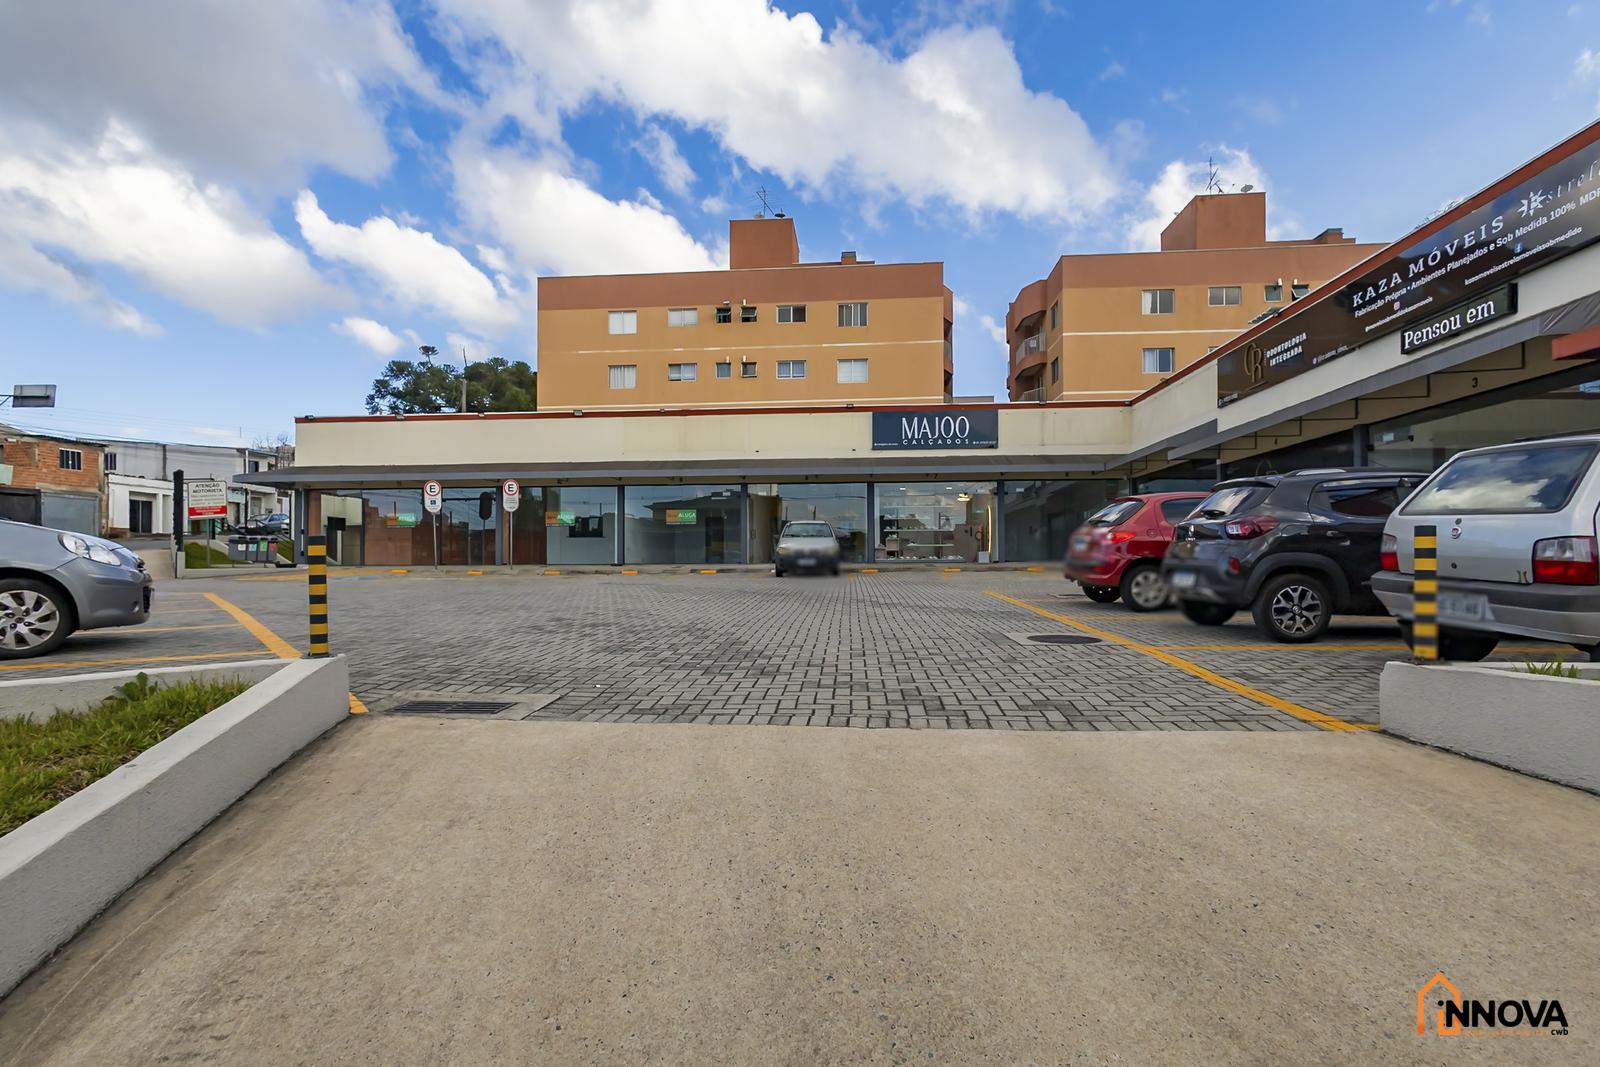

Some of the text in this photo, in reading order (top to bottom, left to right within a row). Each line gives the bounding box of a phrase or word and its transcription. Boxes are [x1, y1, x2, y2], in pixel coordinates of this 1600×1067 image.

[1352, 272, 1402, 307] KAZA
[1408, 215, 1504, 278] MÓVEIS
[1354, 297, 1385, 318] Fabricação
[1411, 267, 1446, 290] Ambientes
[1447, 247, 1488, 272] Planejados
[1489, 243, 1495, 251] e
[1496, 233, 1513, 247] Sob
[1515, 216, 1548, 238] Medida
[1550, 201, 1576, 221] 100%
[1403, 300, 1496, 349] Pensou em
[1266, 332, 1307, 358] ODONTOLOGIA
[1269, 345, 1303, 367] INTEGRADA
[1471, 376, 1479, 389] 3
[901, 415, 970, 439] MAJOO
[902, 438, 969, 446] CALÇADOS
[429, 484, 436, 493] E
[507, 483, 514, 492] E
